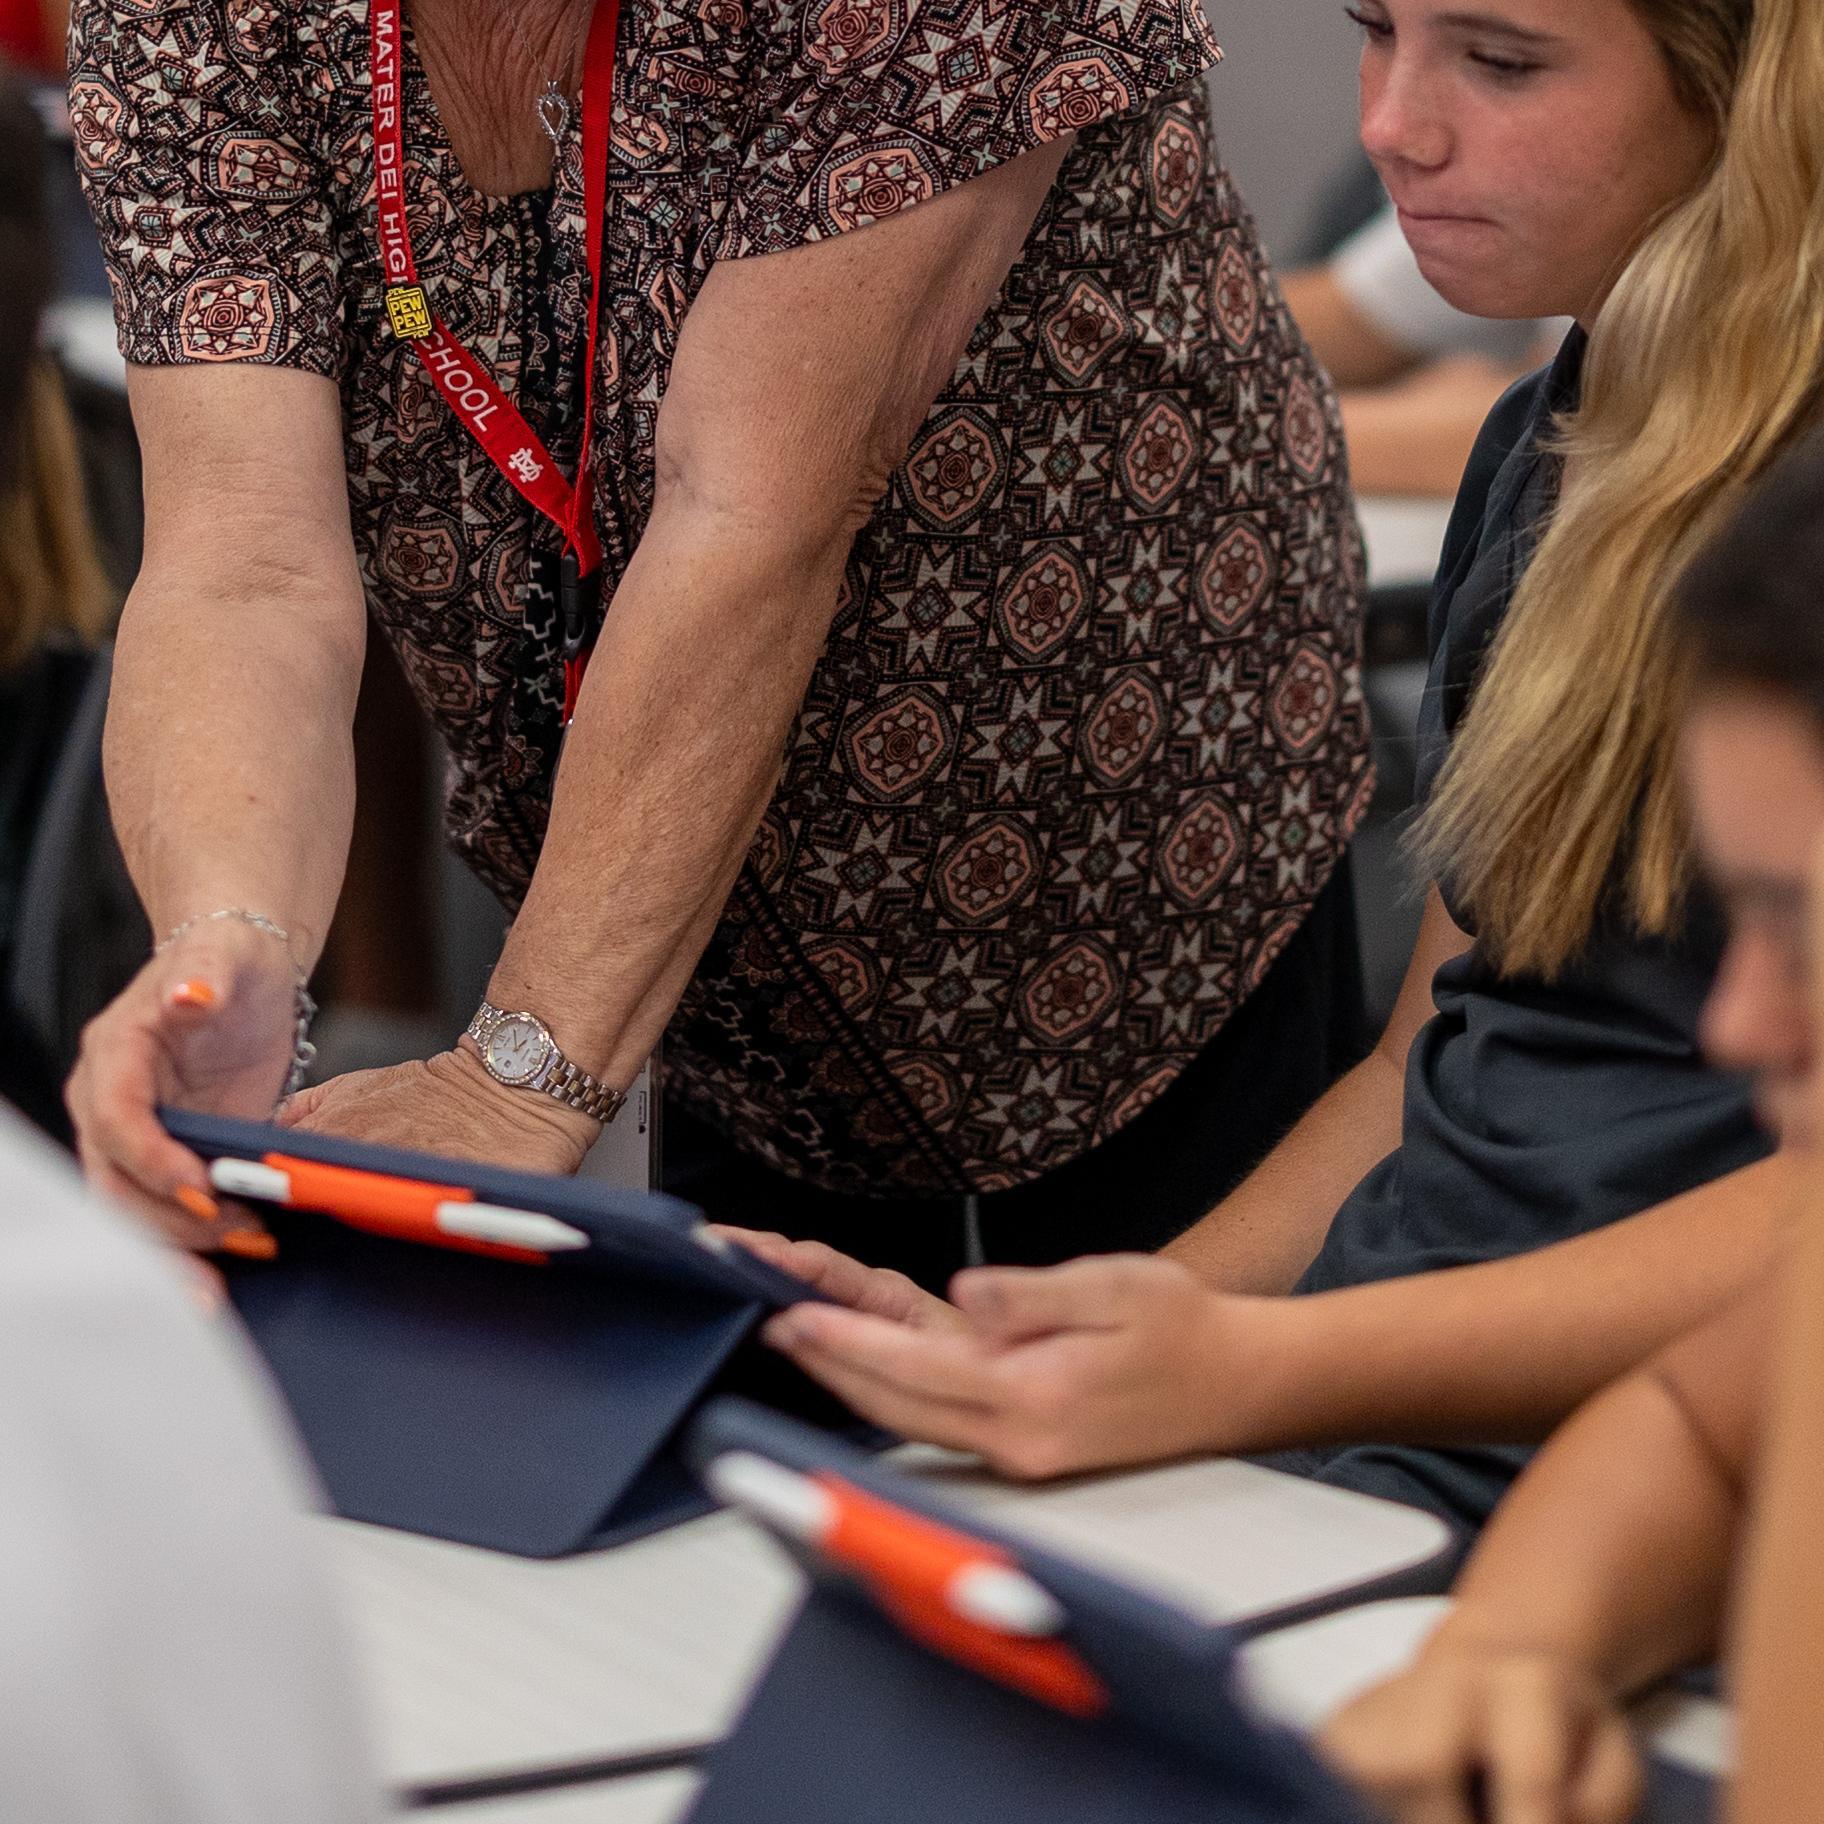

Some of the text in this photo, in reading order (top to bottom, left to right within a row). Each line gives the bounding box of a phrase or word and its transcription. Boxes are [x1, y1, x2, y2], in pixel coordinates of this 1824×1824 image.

[376, 9, 395, 133] MATER
[378, 142, 398, 200] DEI
[389, 295, 422, 316] PEW
[393, 309, 426, 330] PEW
[419, 331, 498, 433] CHOOL
